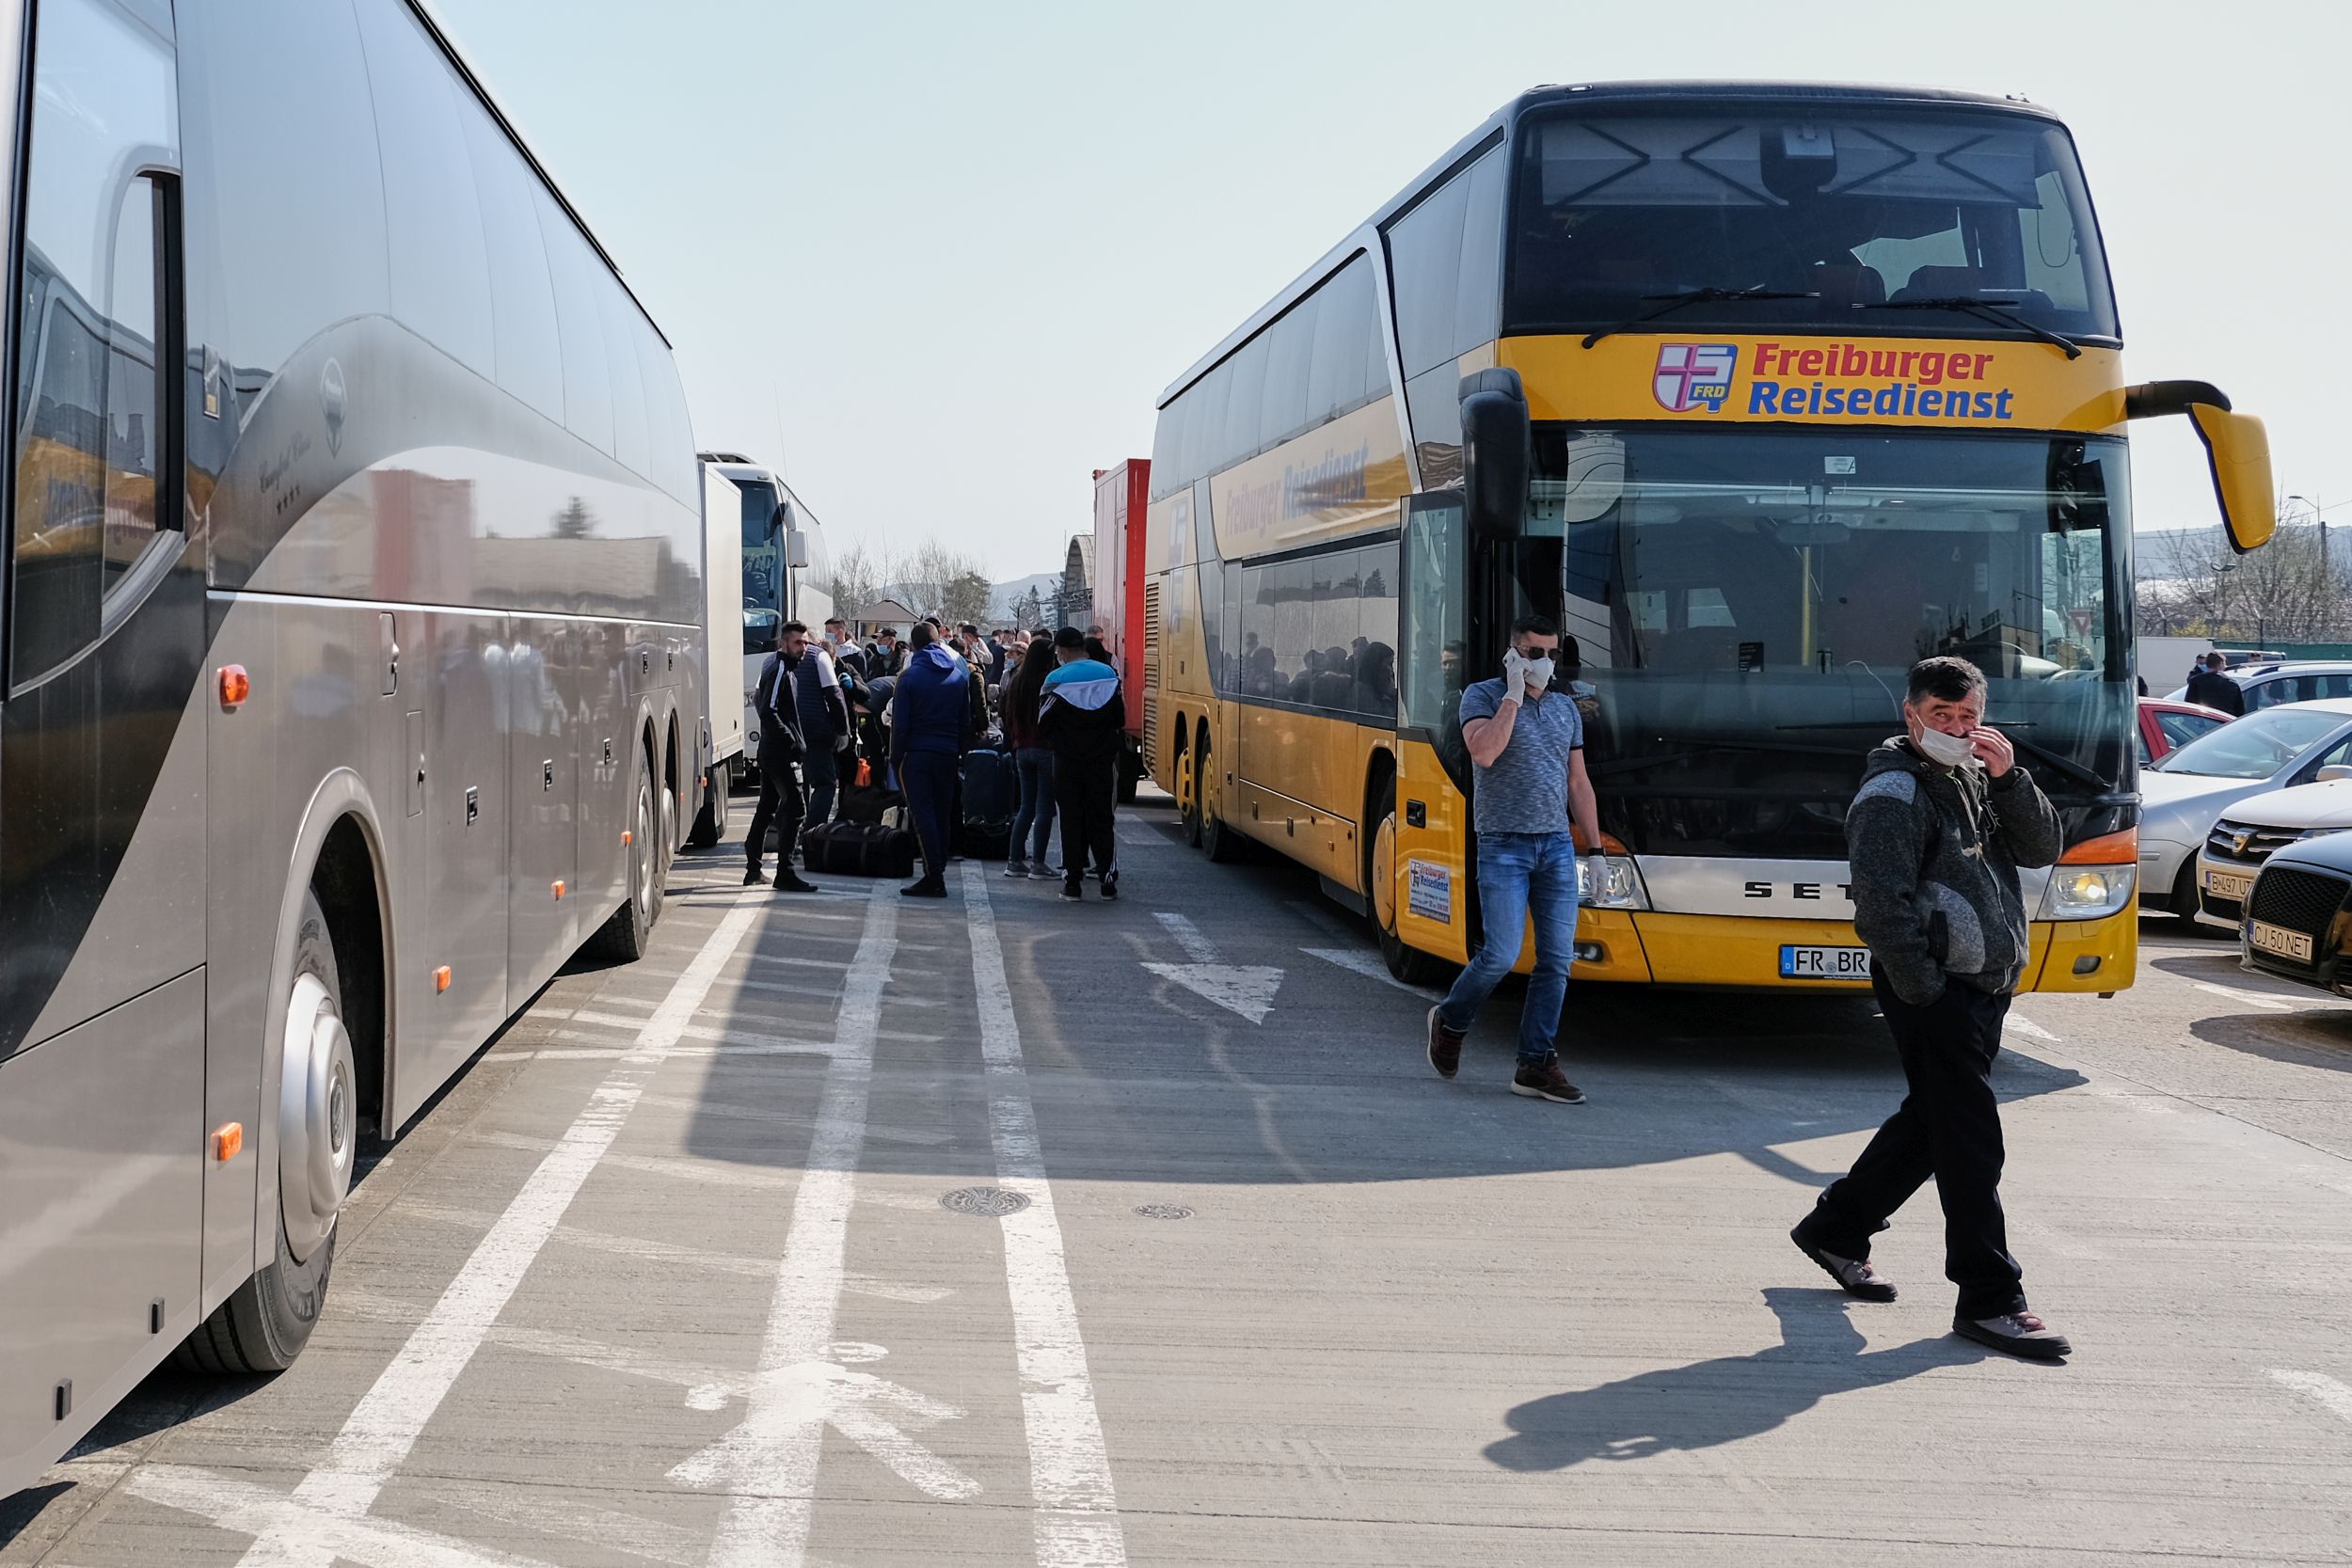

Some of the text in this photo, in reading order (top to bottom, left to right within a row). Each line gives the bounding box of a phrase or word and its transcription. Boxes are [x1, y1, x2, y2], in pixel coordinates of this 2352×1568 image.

[1752, 342, 1994, 385] Freiburger
[1692, 385, 1726, 399] FRD
[1747, 381, 2014, 420] Reisedienst
[1744, 881, 1854, 900] SET
[2212, 875, 2218, 891] B
[2254, 926, 2311, 958] CJ 50 NET
[1796, 950, 1867, 973] FR BR
